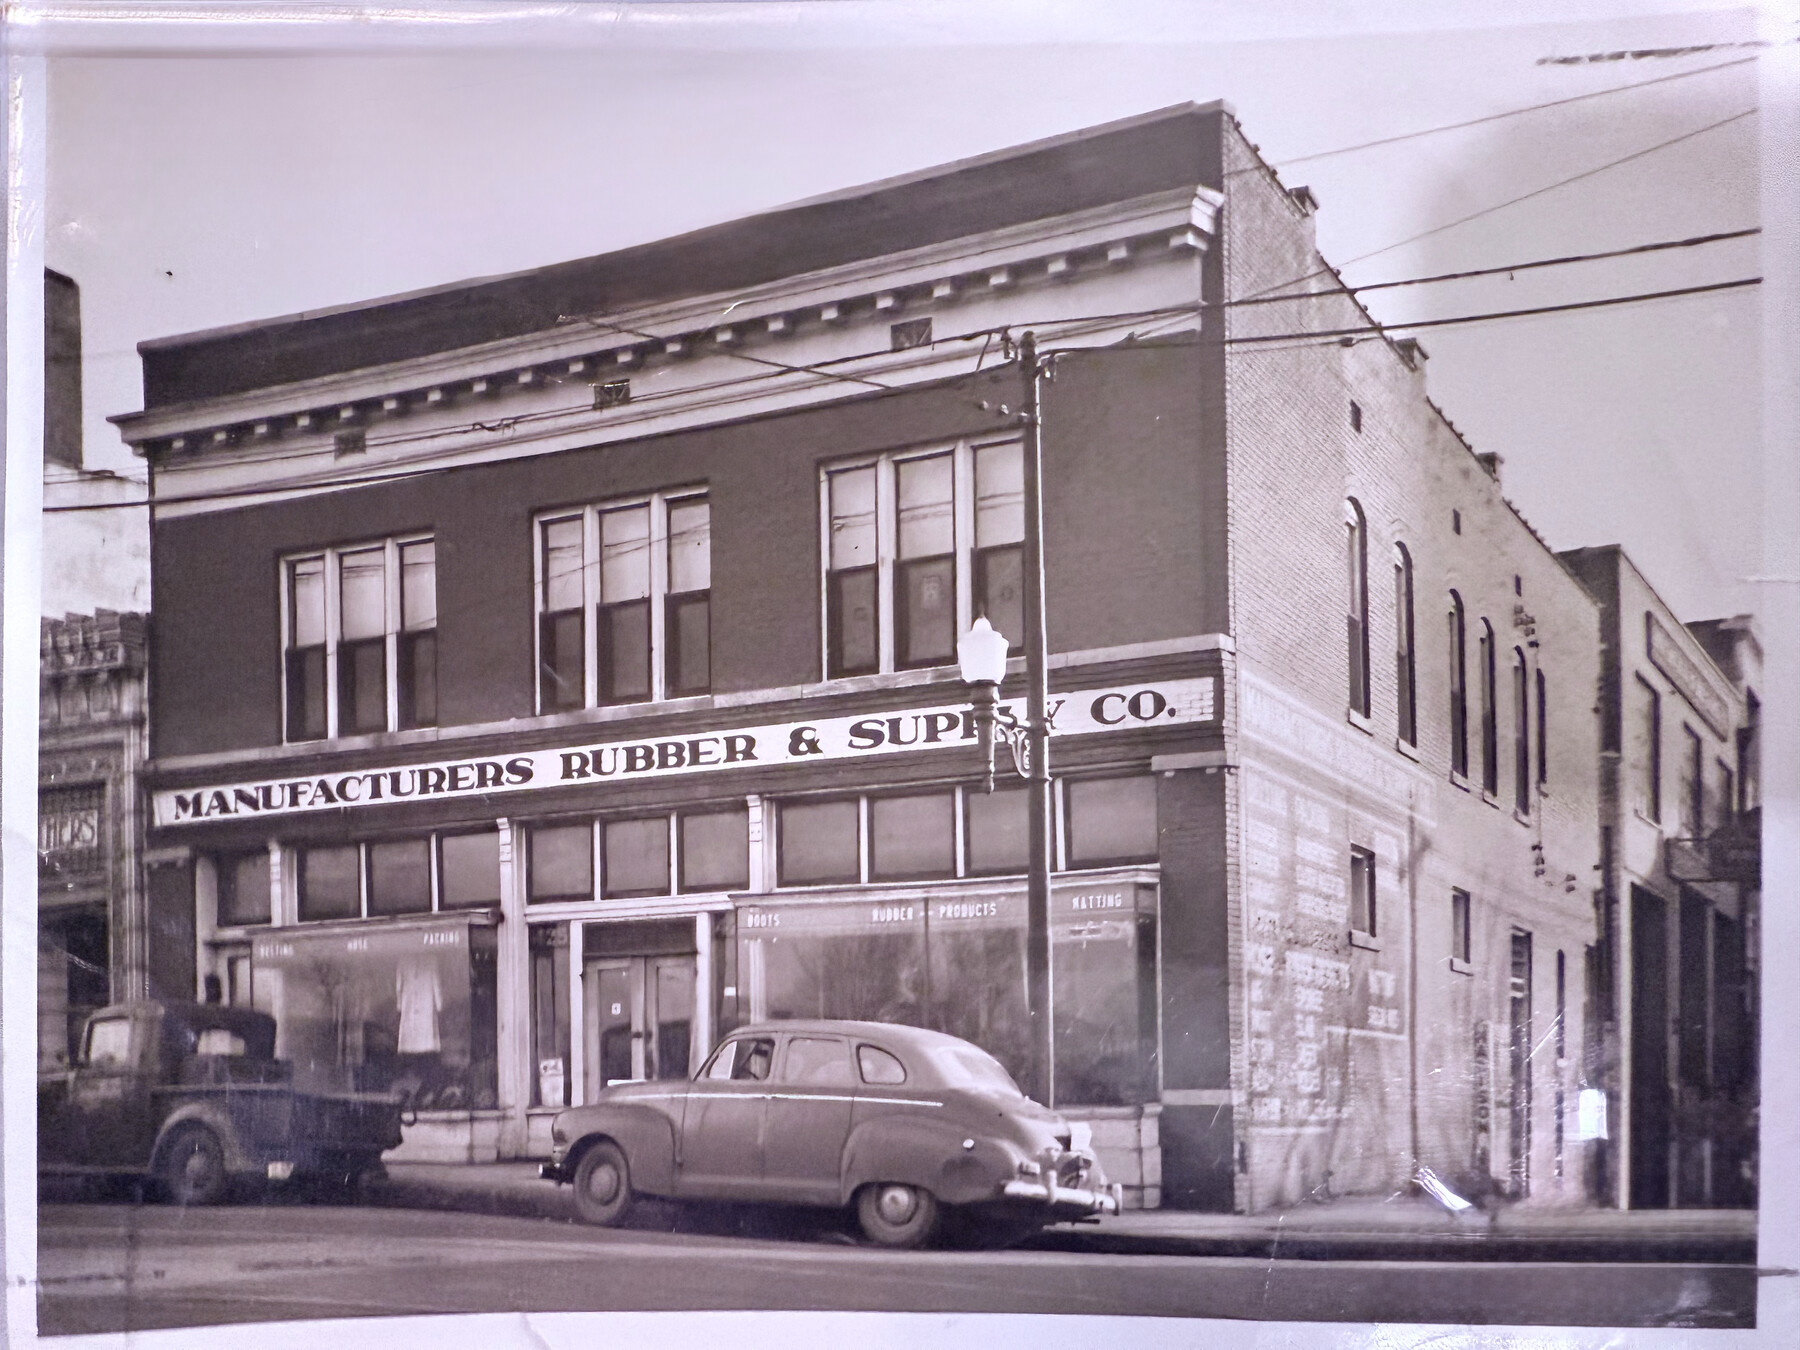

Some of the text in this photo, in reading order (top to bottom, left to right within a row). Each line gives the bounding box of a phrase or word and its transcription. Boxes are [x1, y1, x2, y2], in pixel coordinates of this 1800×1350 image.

[174, 758, 534, 820] MANUFACTURERS
[560, 734, 757, 780] RUBBER
[788, 727, 823, 756] &
[1090, 690, 1177, 725] CO.
[872, 907, 914, 922] RUBBER
[939, 902, 997, 918] PRODUCTS
